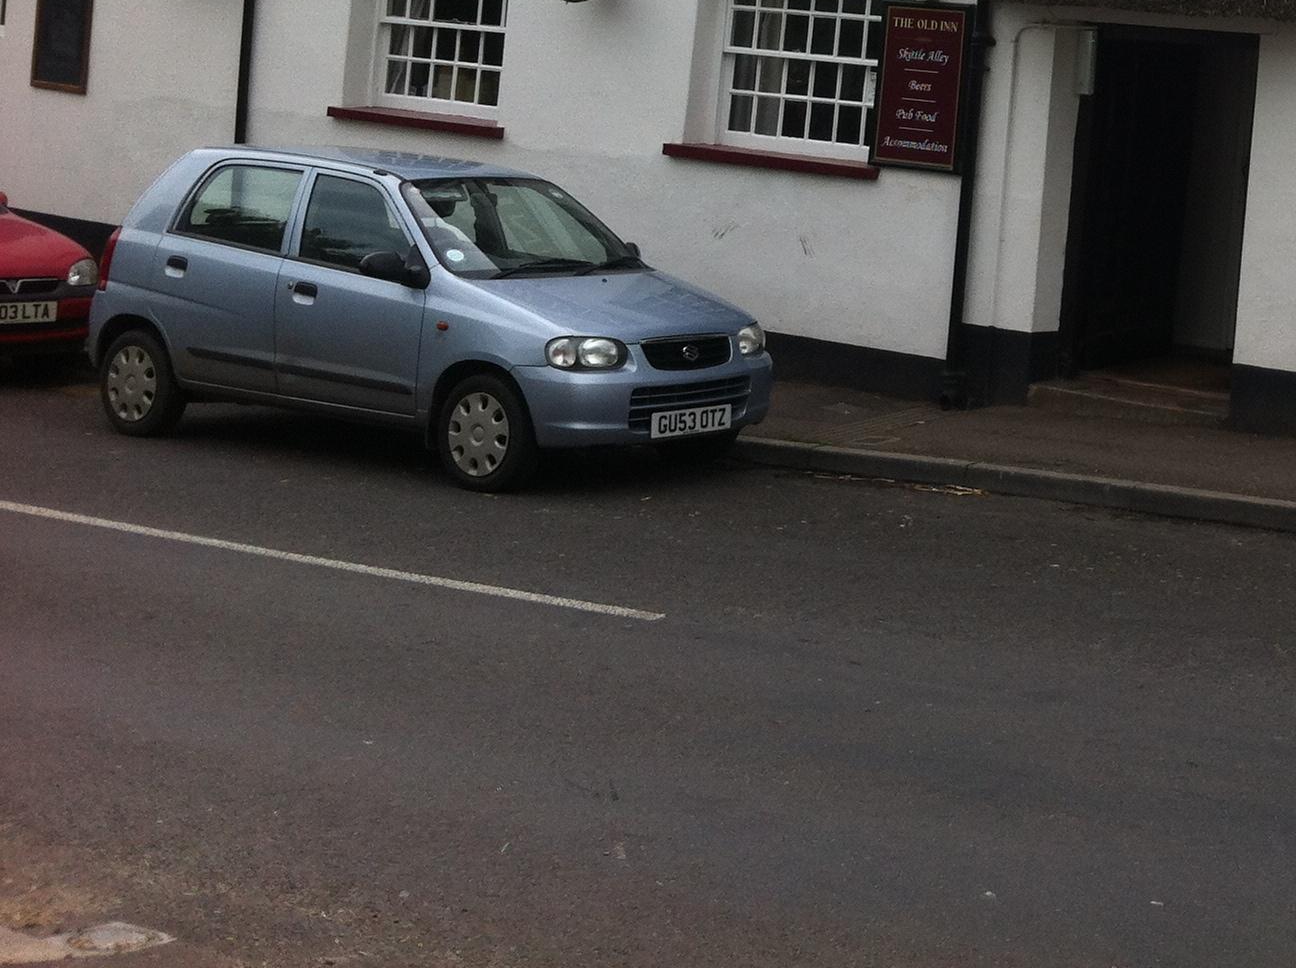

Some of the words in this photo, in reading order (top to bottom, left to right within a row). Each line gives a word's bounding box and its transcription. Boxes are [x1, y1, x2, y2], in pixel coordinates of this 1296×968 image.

[893, 16, 915, 29] THE
[917, 19, 938, 31] OLD
[940, 20, 959, 33] INN
[926, 50, 950, 66] Alley
[908, 79, 932, 92] Beers
[896, 108, 914, 120] Pub
[914, 110, 938, 122] Food
[882, 136, 948, 153] Accommodation
[22, 303, 49, 319] LTA
[658, 412, 697, 434] GU53
